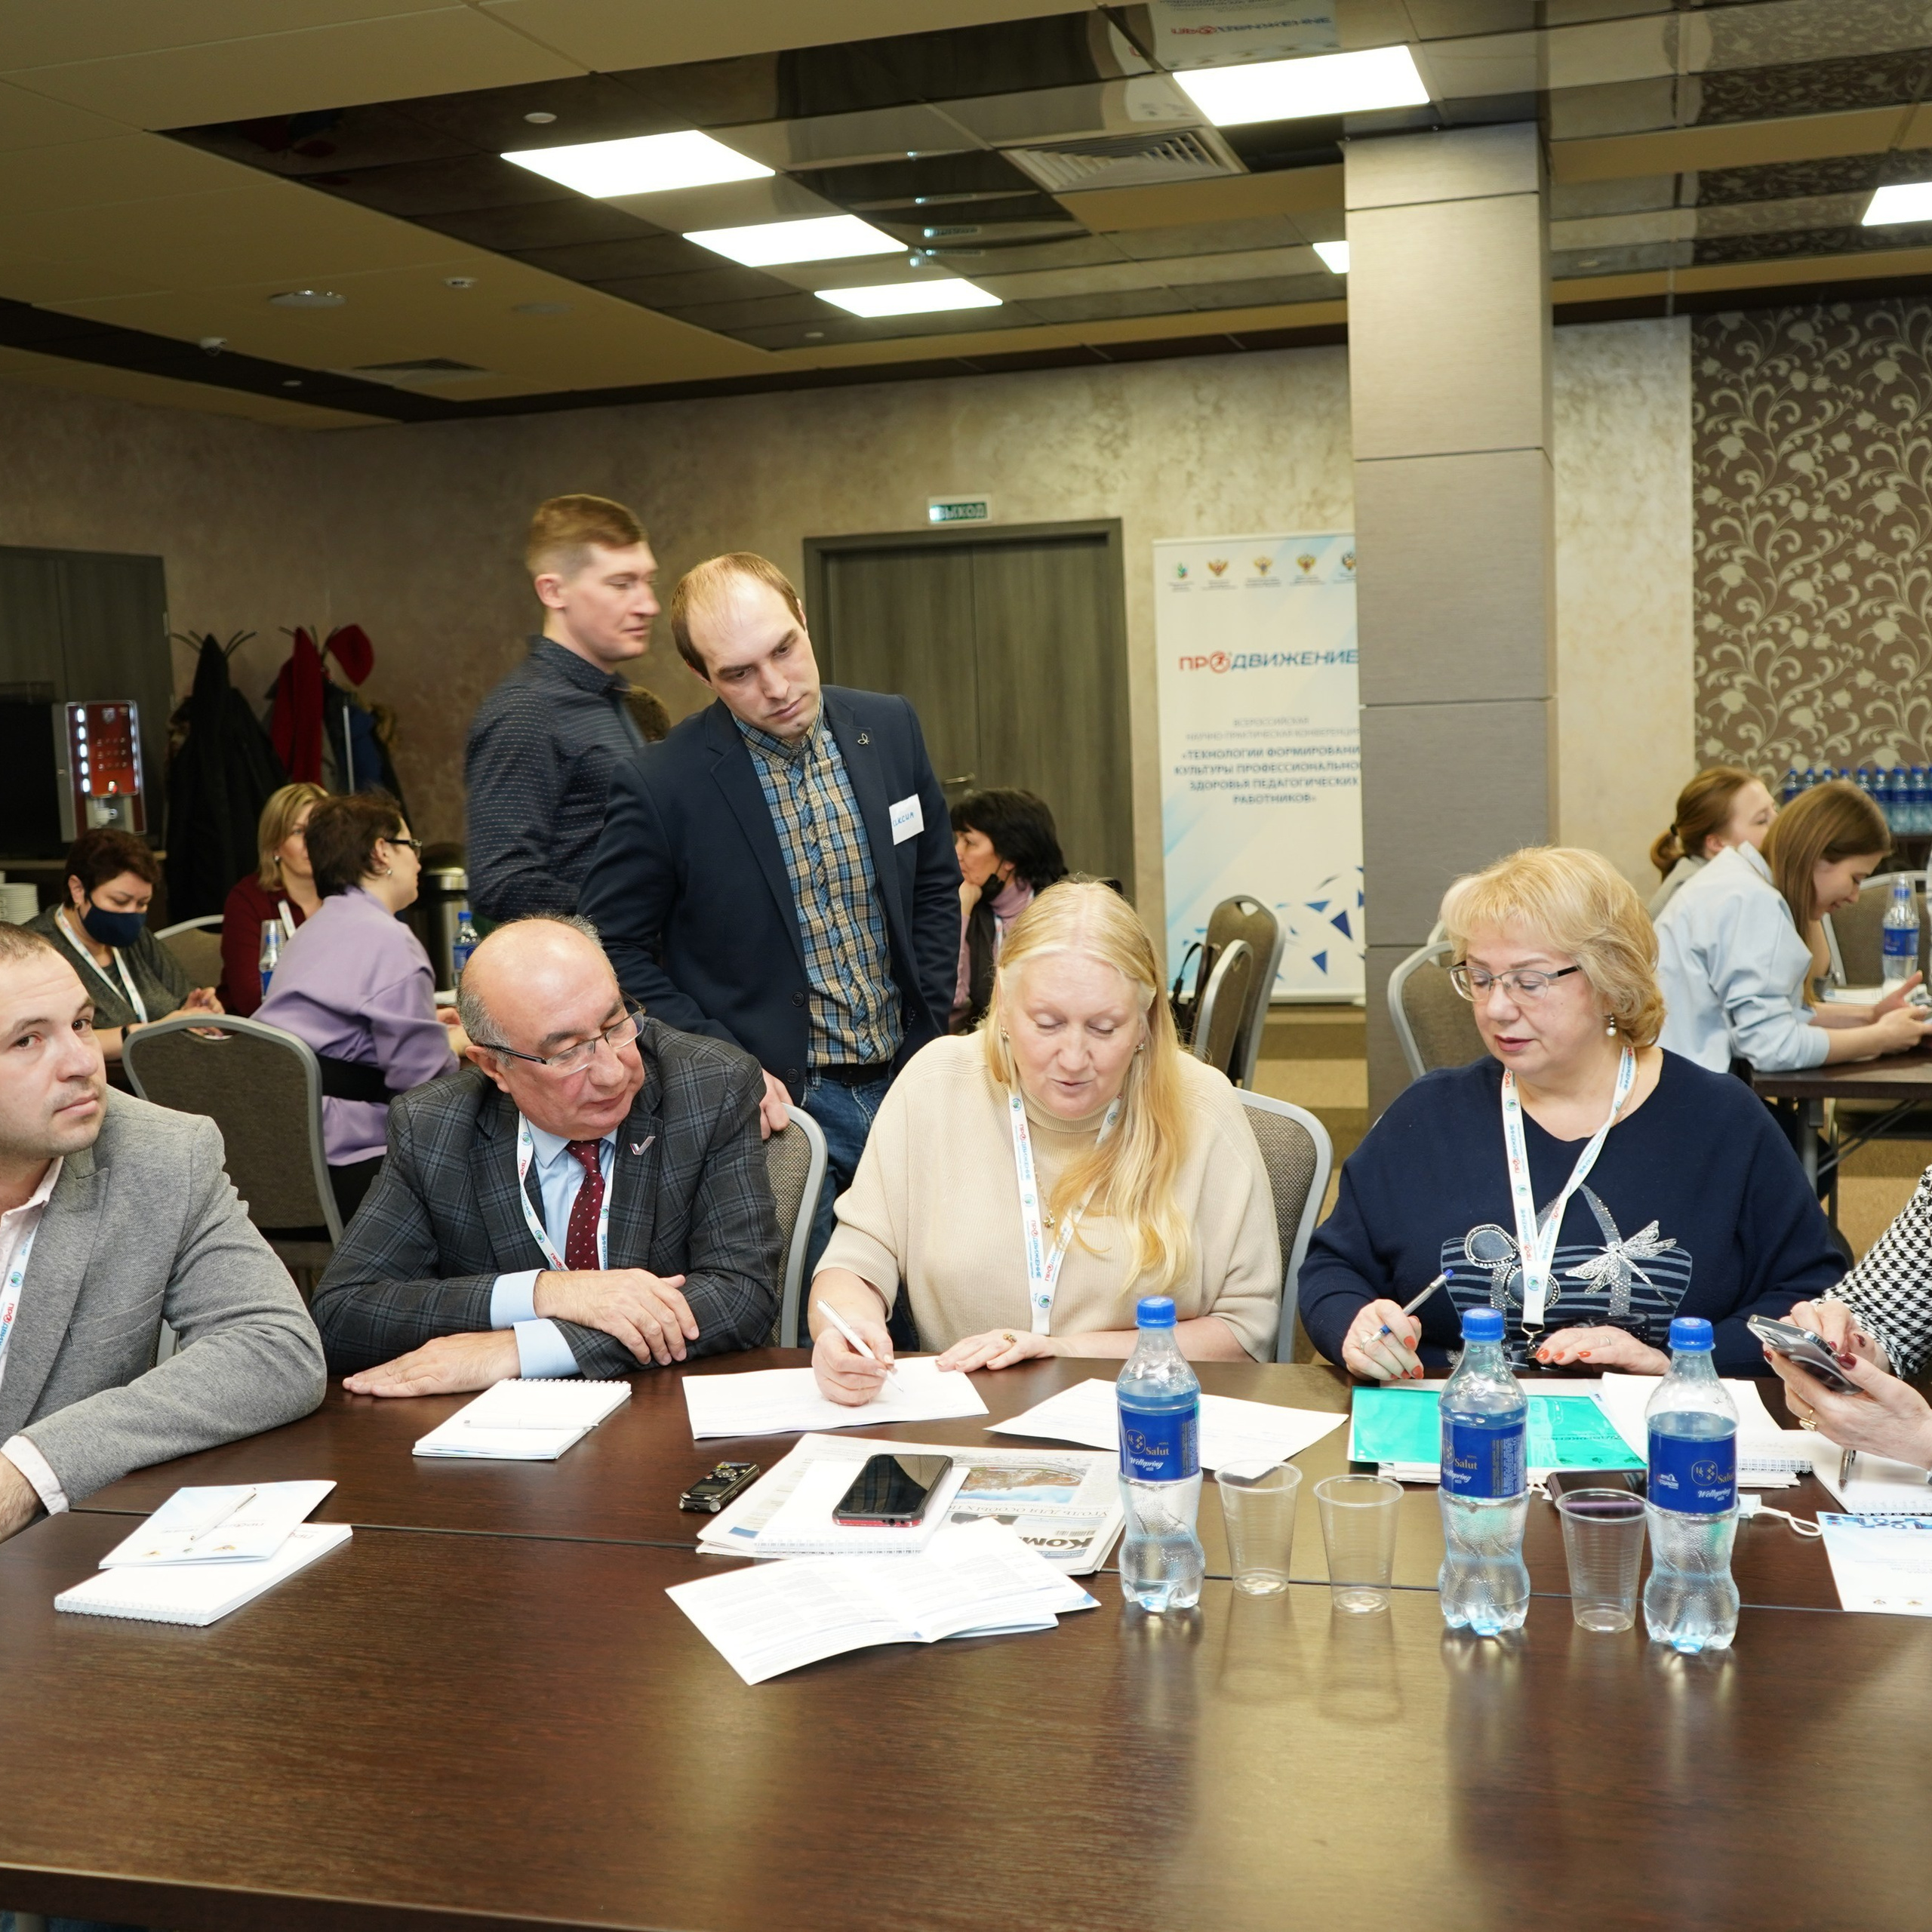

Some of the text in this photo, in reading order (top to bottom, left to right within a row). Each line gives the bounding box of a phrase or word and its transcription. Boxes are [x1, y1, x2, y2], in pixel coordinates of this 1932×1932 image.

[1267, 746, 1360, 757] ФОРМИРОВАНИ
[1175, 761, 1361, 775] КУЛЬТУРЫ ПРОФЕССИОНАЛЬНО
[1189, 777, 1358, 791] ЗДОРОВЬЯ ПЕДАГОГИЧЕСКИХ
[1146, 1447, 1170, 1456] Salut
[1130, 1457, 1164, 1470] Wellspring
[1454, 1458, 1478, 1470] Salut
